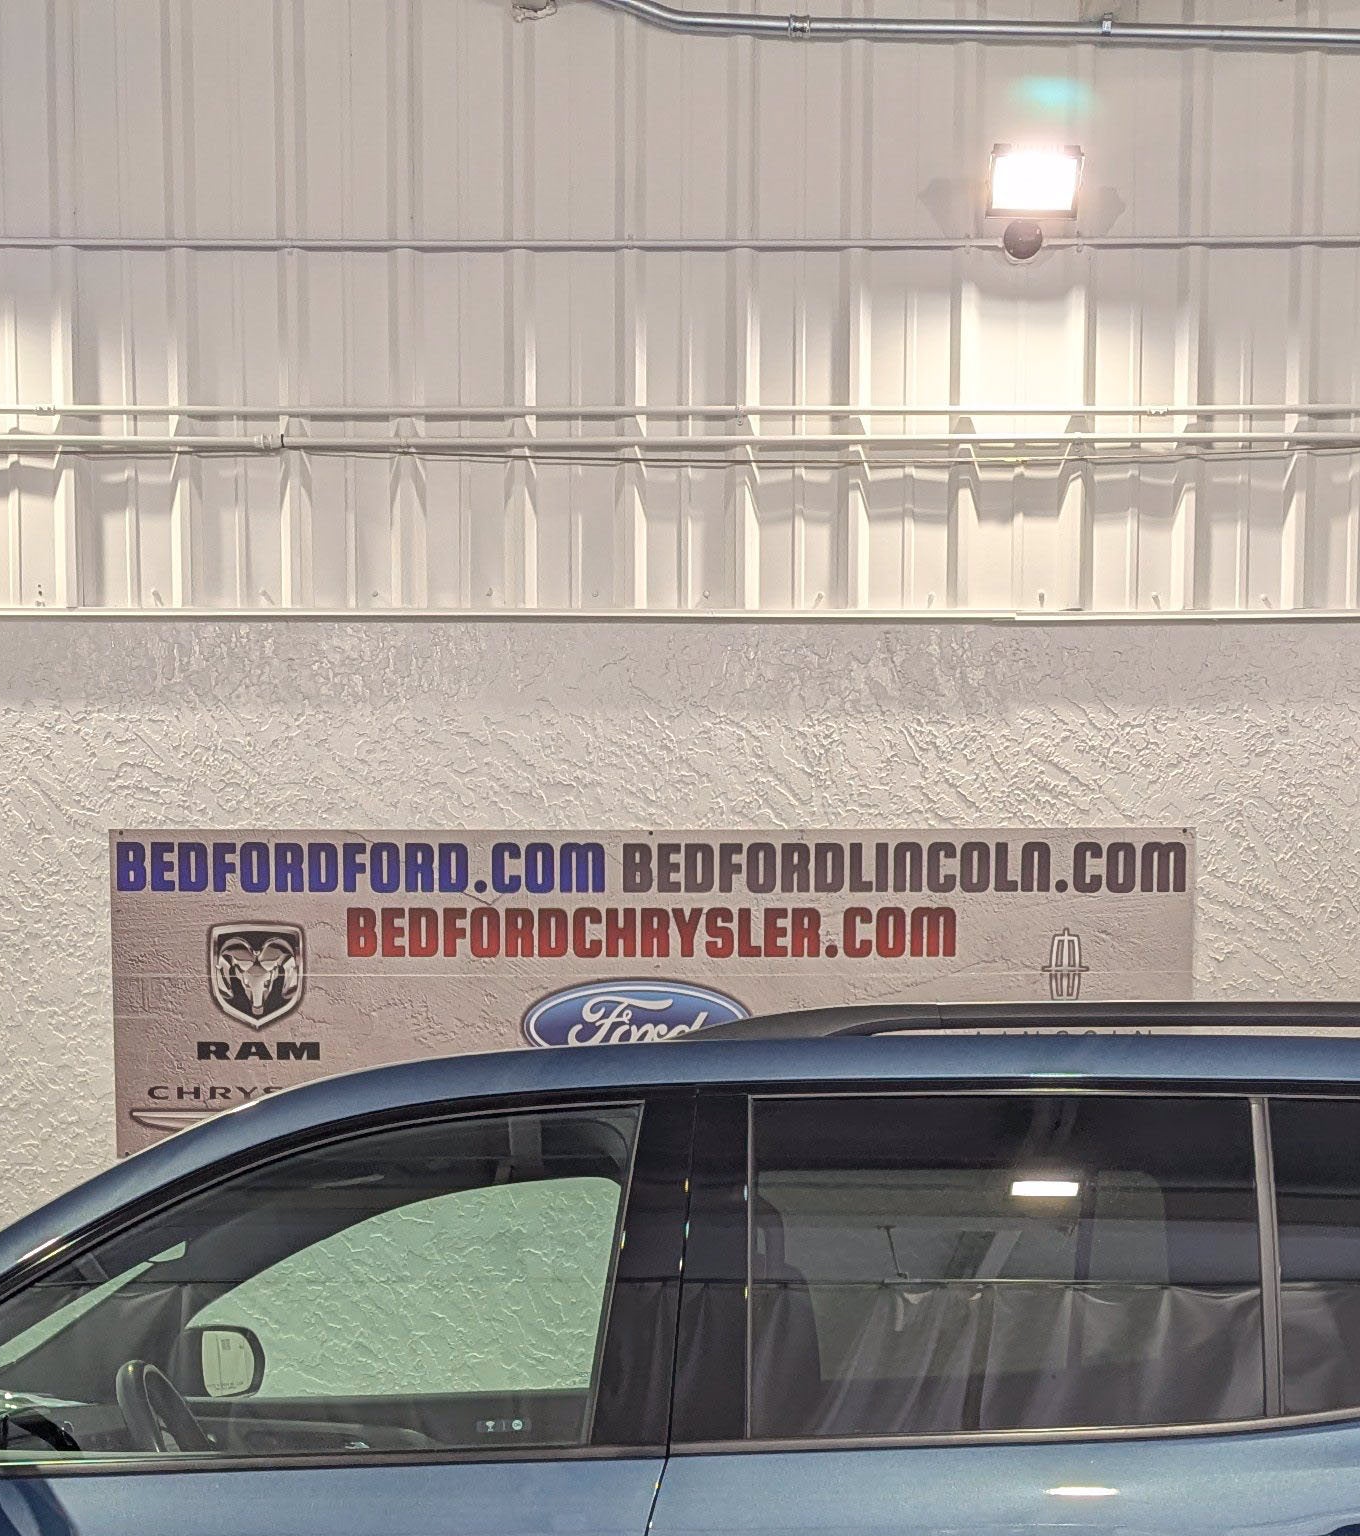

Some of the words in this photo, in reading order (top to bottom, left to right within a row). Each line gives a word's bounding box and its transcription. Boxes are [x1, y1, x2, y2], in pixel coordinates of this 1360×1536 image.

[115, 841, 605, 894] BEDFORDFORD.COM
[622, 841, 1186, 893] BEDFORDLINCOLN.COM
[346, 906, 956, 959] BEDFORDCHRYSLER.COM
[197, 1041, 320, 1060] RAM
